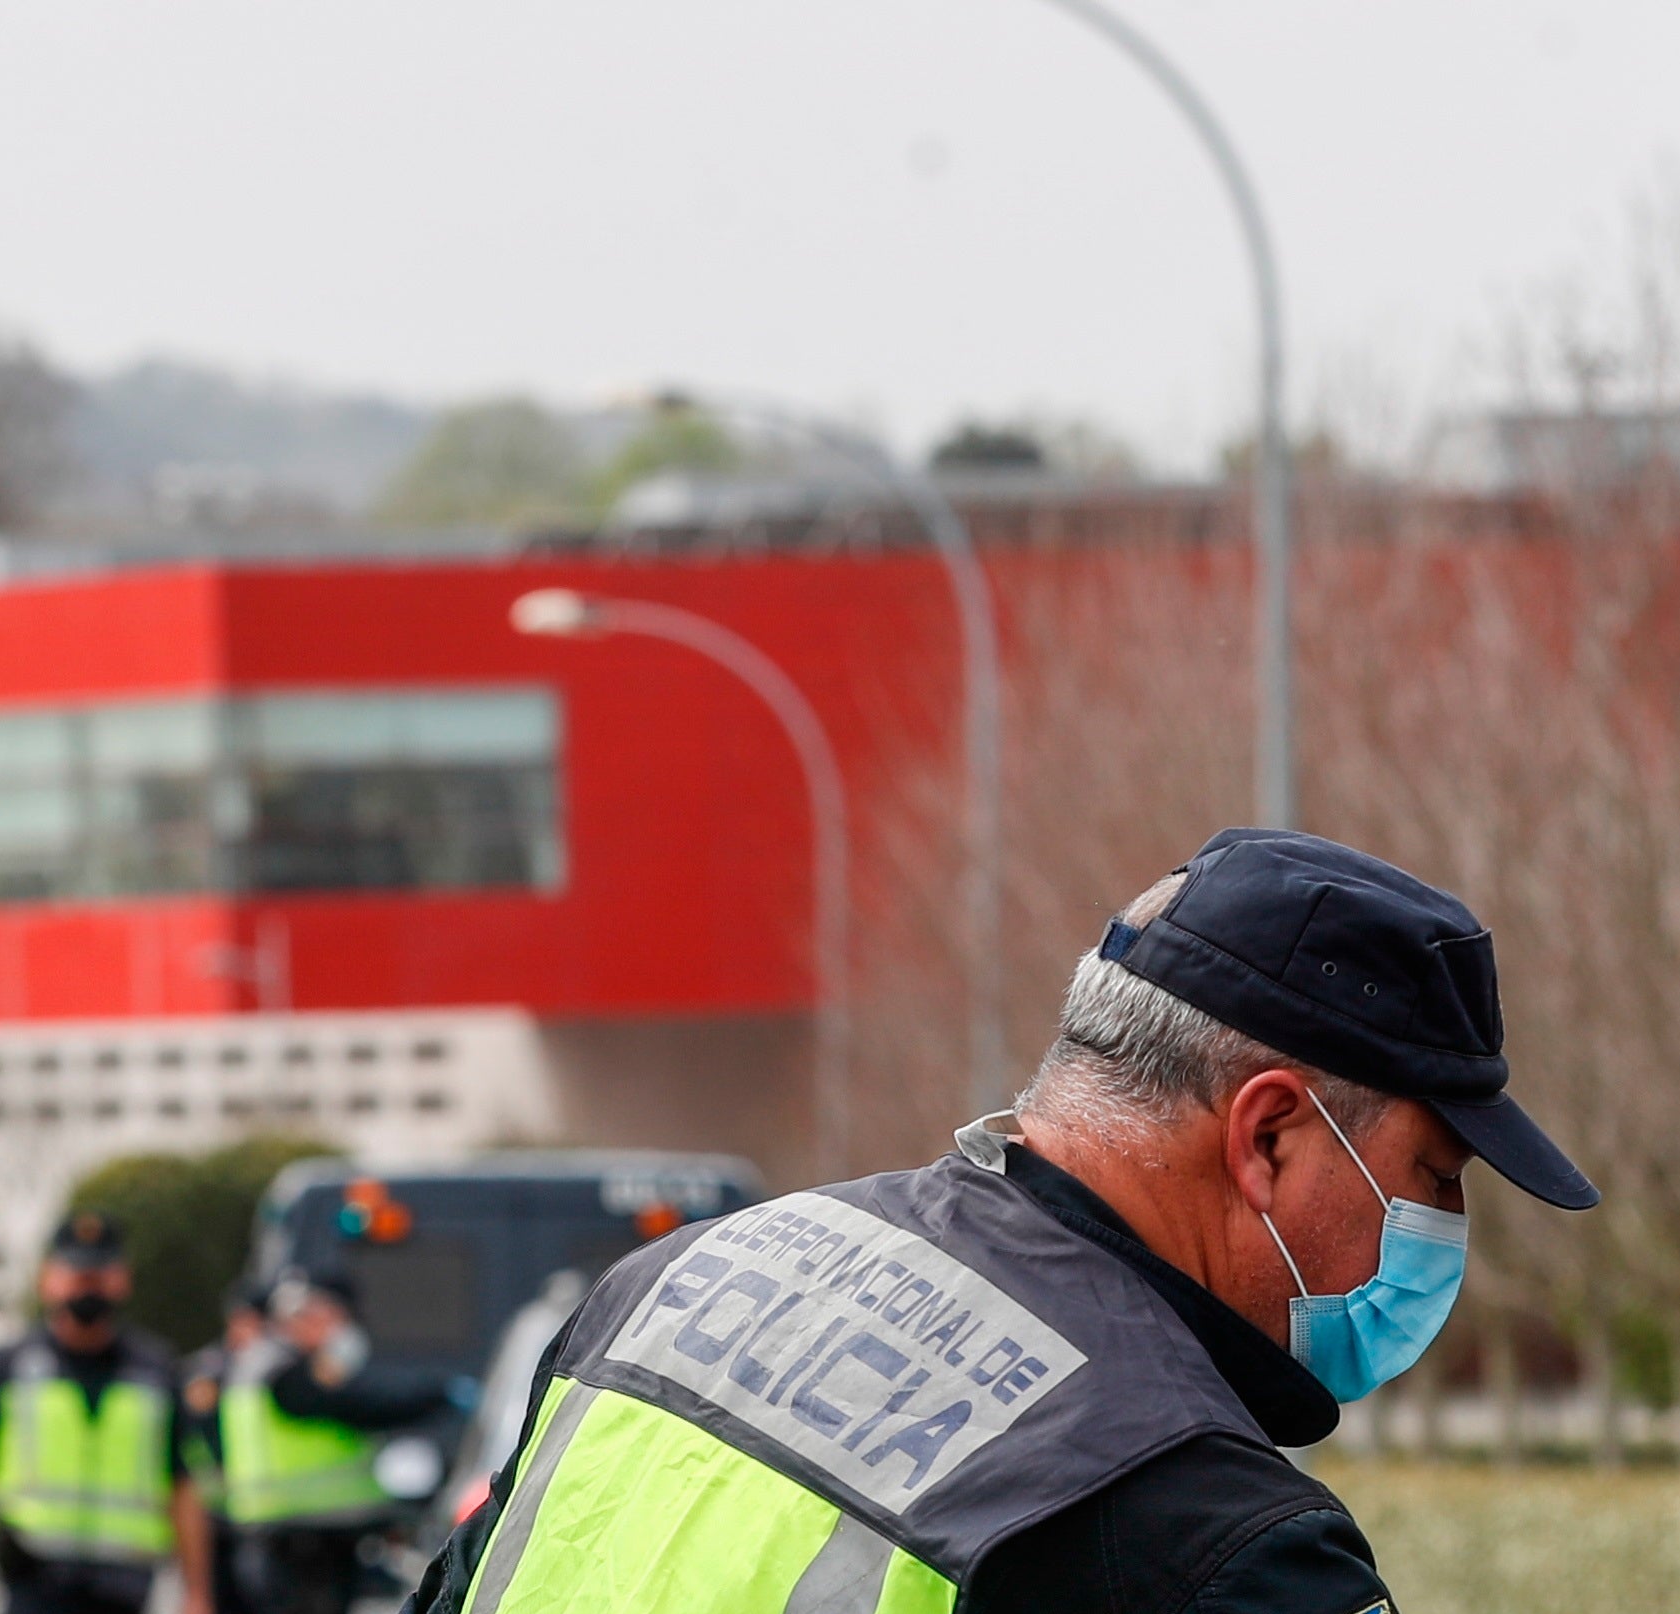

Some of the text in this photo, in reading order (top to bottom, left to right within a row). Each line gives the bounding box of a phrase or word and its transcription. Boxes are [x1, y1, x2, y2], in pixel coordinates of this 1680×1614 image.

[630, 1250, 974, 1491] POLICIA
[716, 1206, 1050, 1407] CUERPO NACIONAL DE
